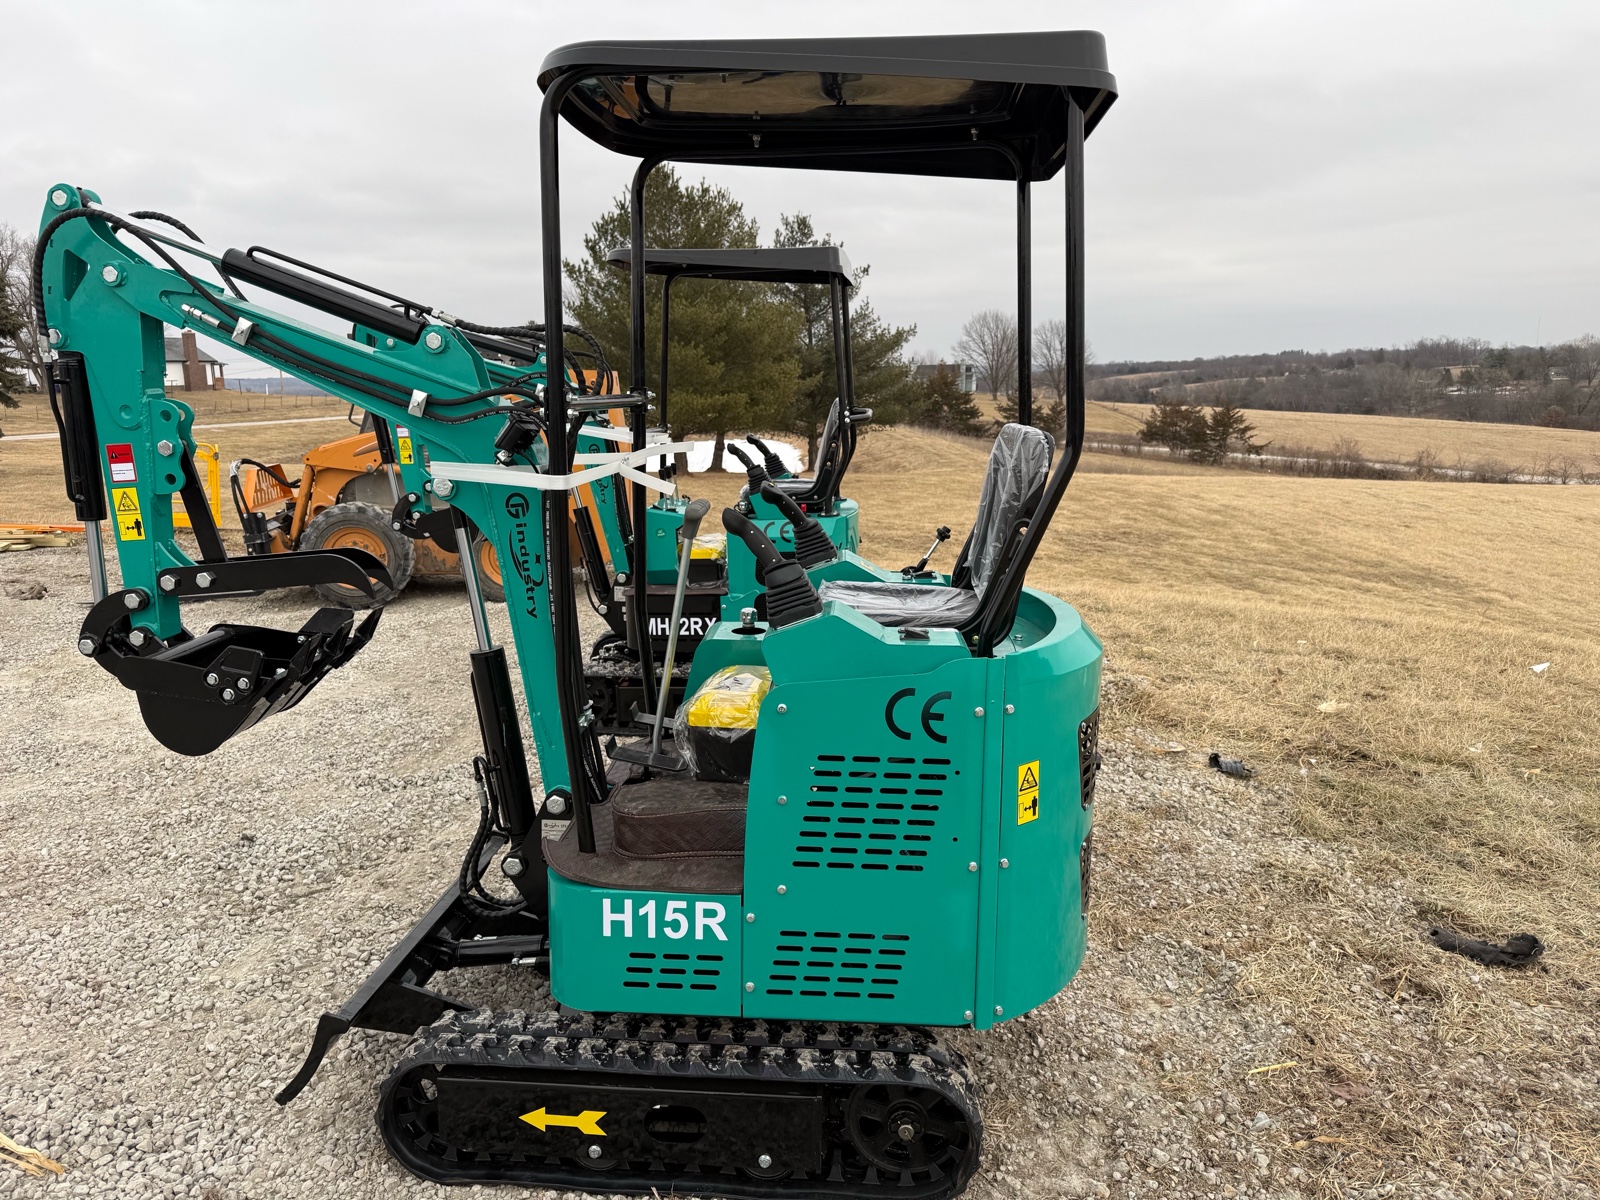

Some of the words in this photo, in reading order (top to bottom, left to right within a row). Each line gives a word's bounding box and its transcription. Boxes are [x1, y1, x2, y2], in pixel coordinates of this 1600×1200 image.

[763, 521, 792, 544] CE
[515, 522, 538, 619] industry
[648, 617, 717, 636] MH2RX
[885, 687, 952, 744] CE
[602, 898, 728, 941] H15R
